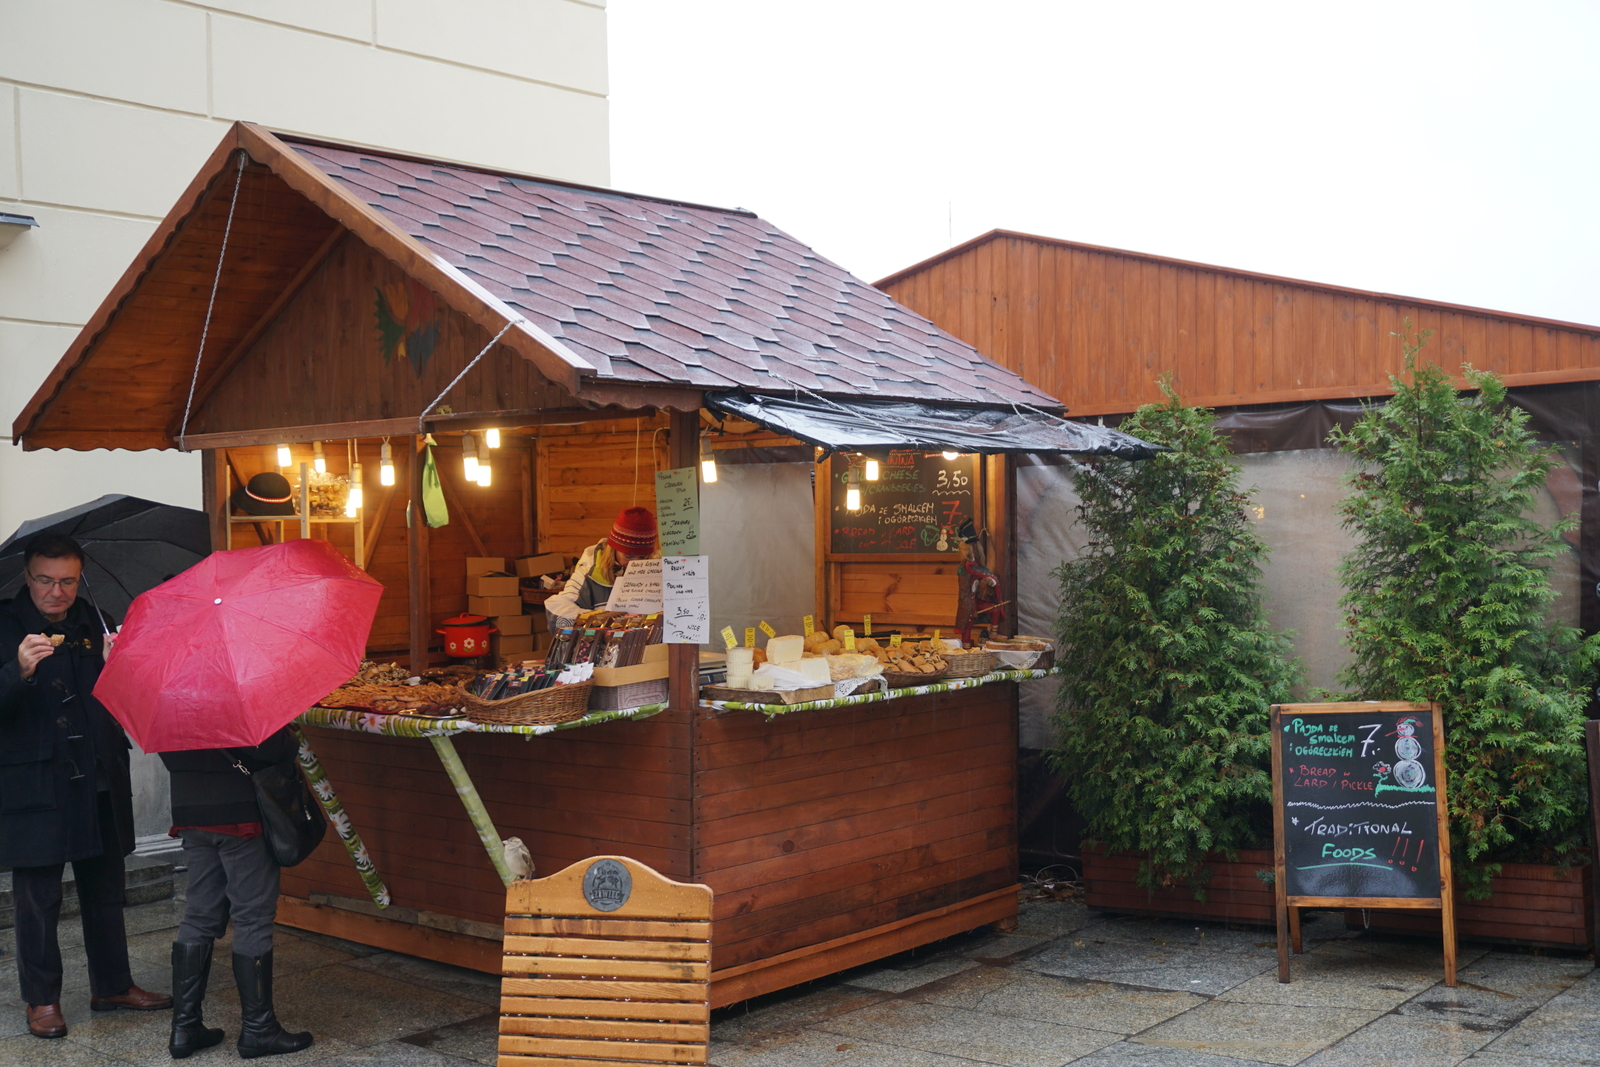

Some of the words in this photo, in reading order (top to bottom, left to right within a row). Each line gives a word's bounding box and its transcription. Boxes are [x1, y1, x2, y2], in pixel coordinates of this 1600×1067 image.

[882, 469, 920, 480] CHEESE
[936, 469, 969, 489] 3,50
[1299, 764, 1337, 777] BREAD
[1294, 777, 1328, 789] LARD
[1341, 780, 1374, 790] PICKLE
